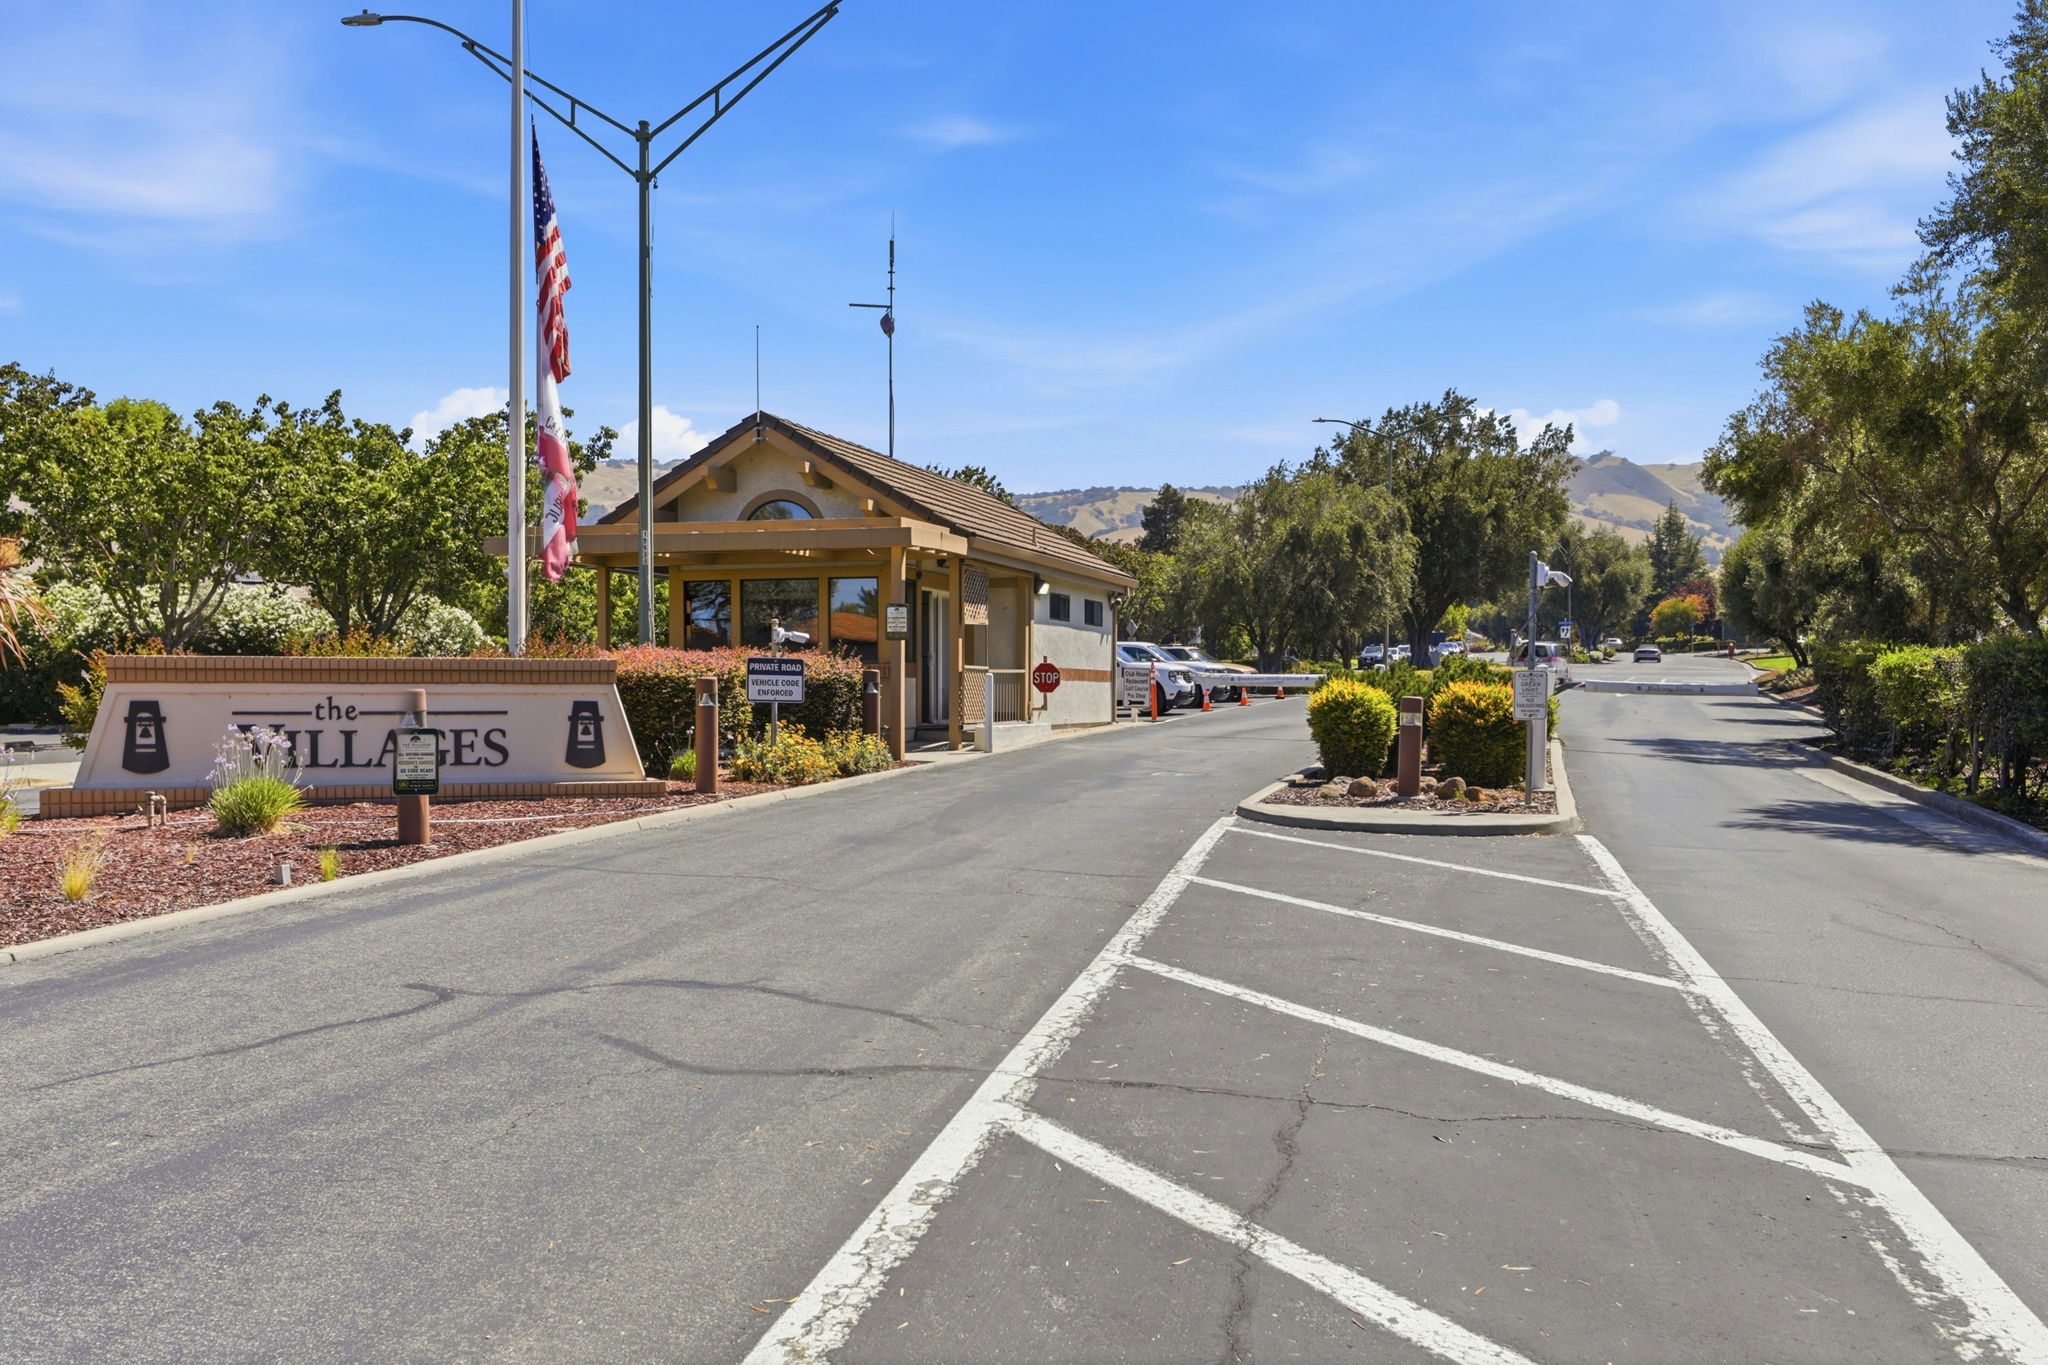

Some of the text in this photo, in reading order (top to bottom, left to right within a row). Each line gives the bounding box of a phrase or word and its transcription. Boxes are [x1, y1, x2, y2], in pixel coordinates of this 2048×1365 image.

[750, 662, 802, 672] PRIVATE ROAD
[751, 678, 800, 687] VEHICLE CODE
[1034, 672, 1060, 684] STOP
[757, 688, 794, 697] ENFORCED
[314, 696, 359, 721] the
